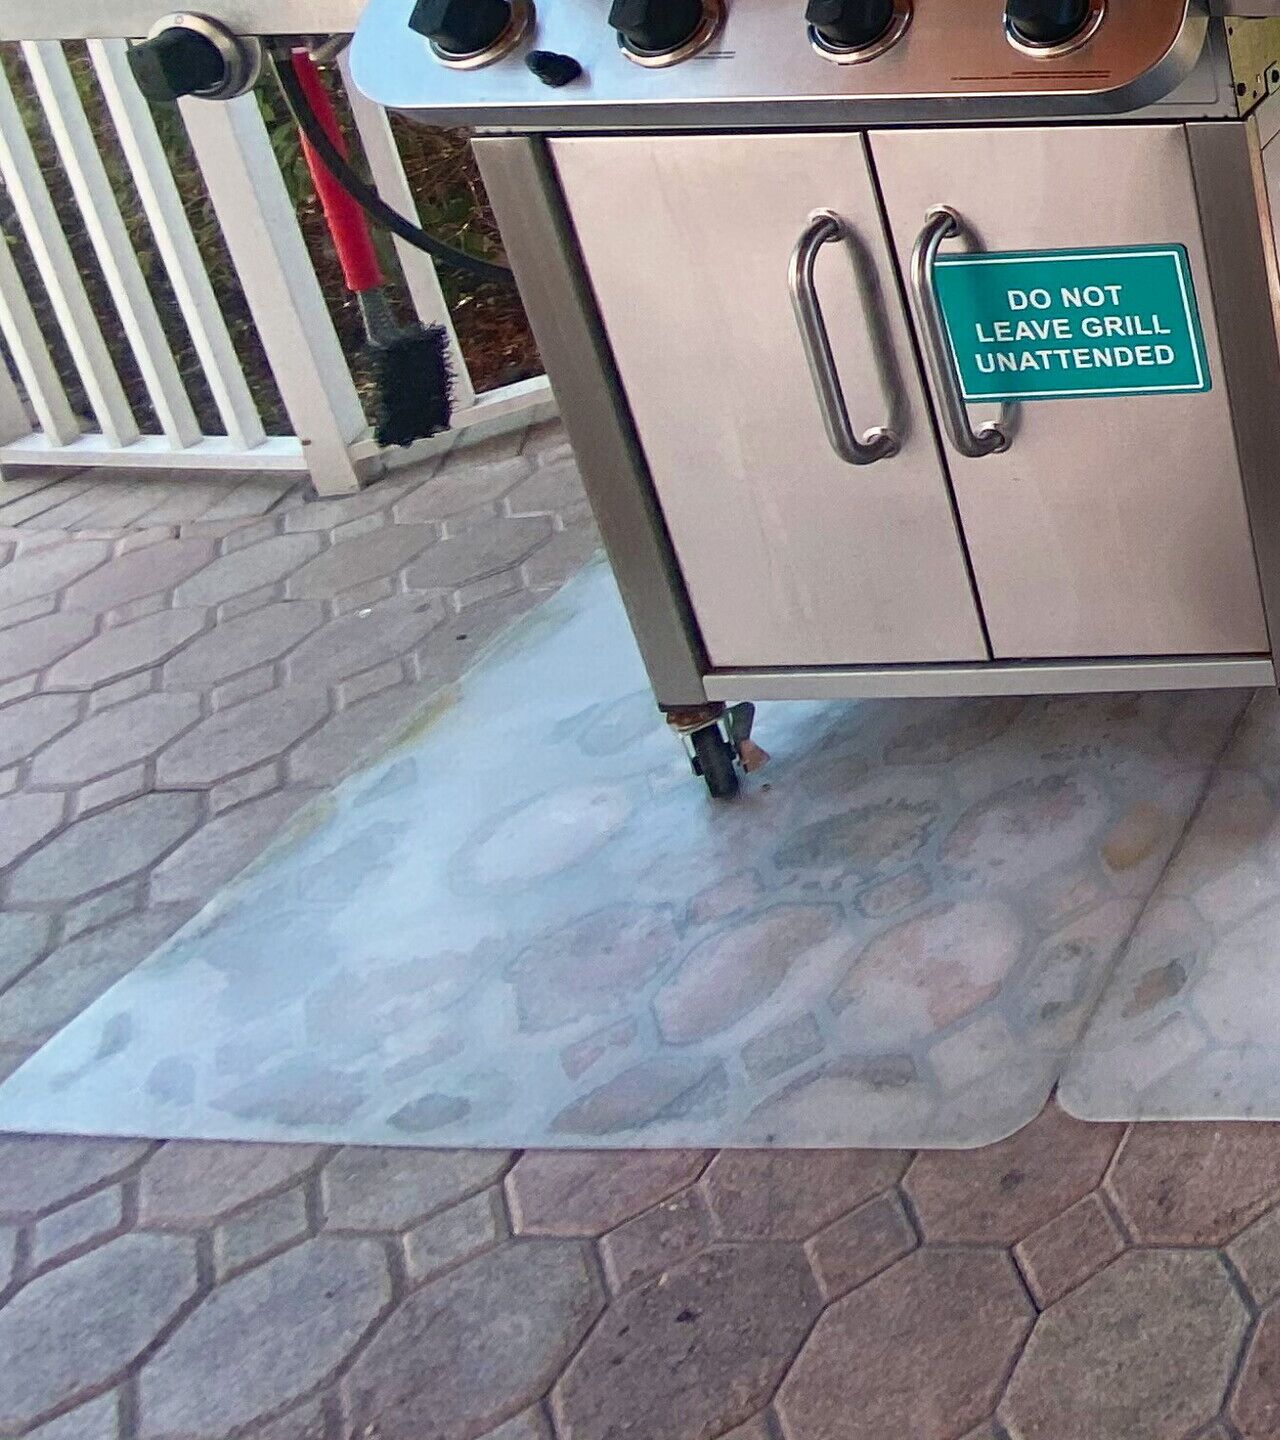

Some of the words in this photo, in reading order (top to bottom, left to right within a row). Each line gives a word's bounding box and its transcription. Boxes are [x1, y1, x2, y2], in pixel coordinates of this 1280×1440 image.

[1007, 288, 1051, 311] DO
[1061, 285, 1122, 308] NOT
[975, 318, 1073, 343] LEAVE
[1081, 314, 1171, 338] GRILL
[975, 345, 1175, 374] UNATTENDED
